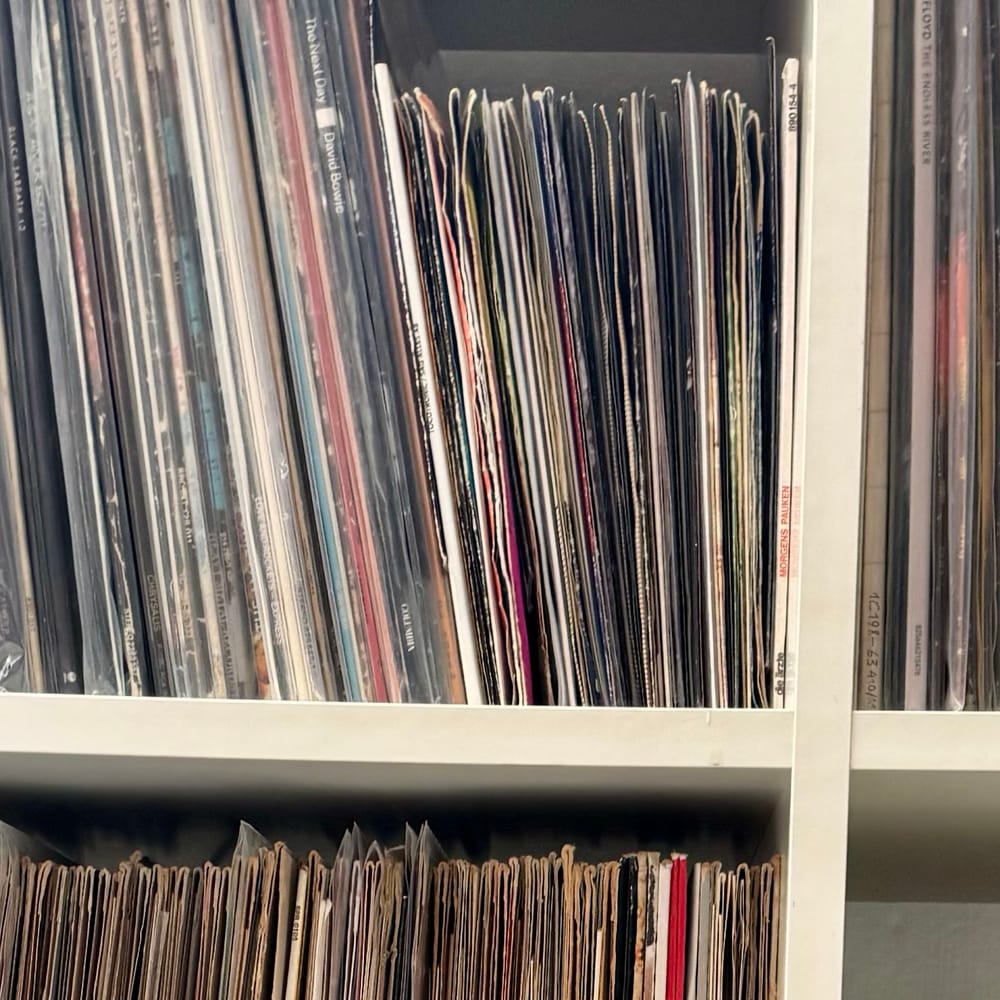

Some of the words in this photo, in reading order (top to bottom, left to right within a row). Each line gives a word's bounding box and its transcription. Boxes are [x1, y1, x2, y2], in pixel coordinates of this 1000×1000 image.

[304, 18, 317, 43] The
[308, 44, 323, 75] Next
[922, 45, 932, 67] THE
[313, 78, 328, 104] Day
[8, 126, 19, 161] BLACK
[324, 132, 339, 170] David
[921, 131, 931, 165] RIVER
[12, 165, 25, 215] SABBATH
[331, 173, 346, 214] Bowie
[780, 486, 791, 525] PAUKEN
[778, 529, 789, 577] MORGENS
